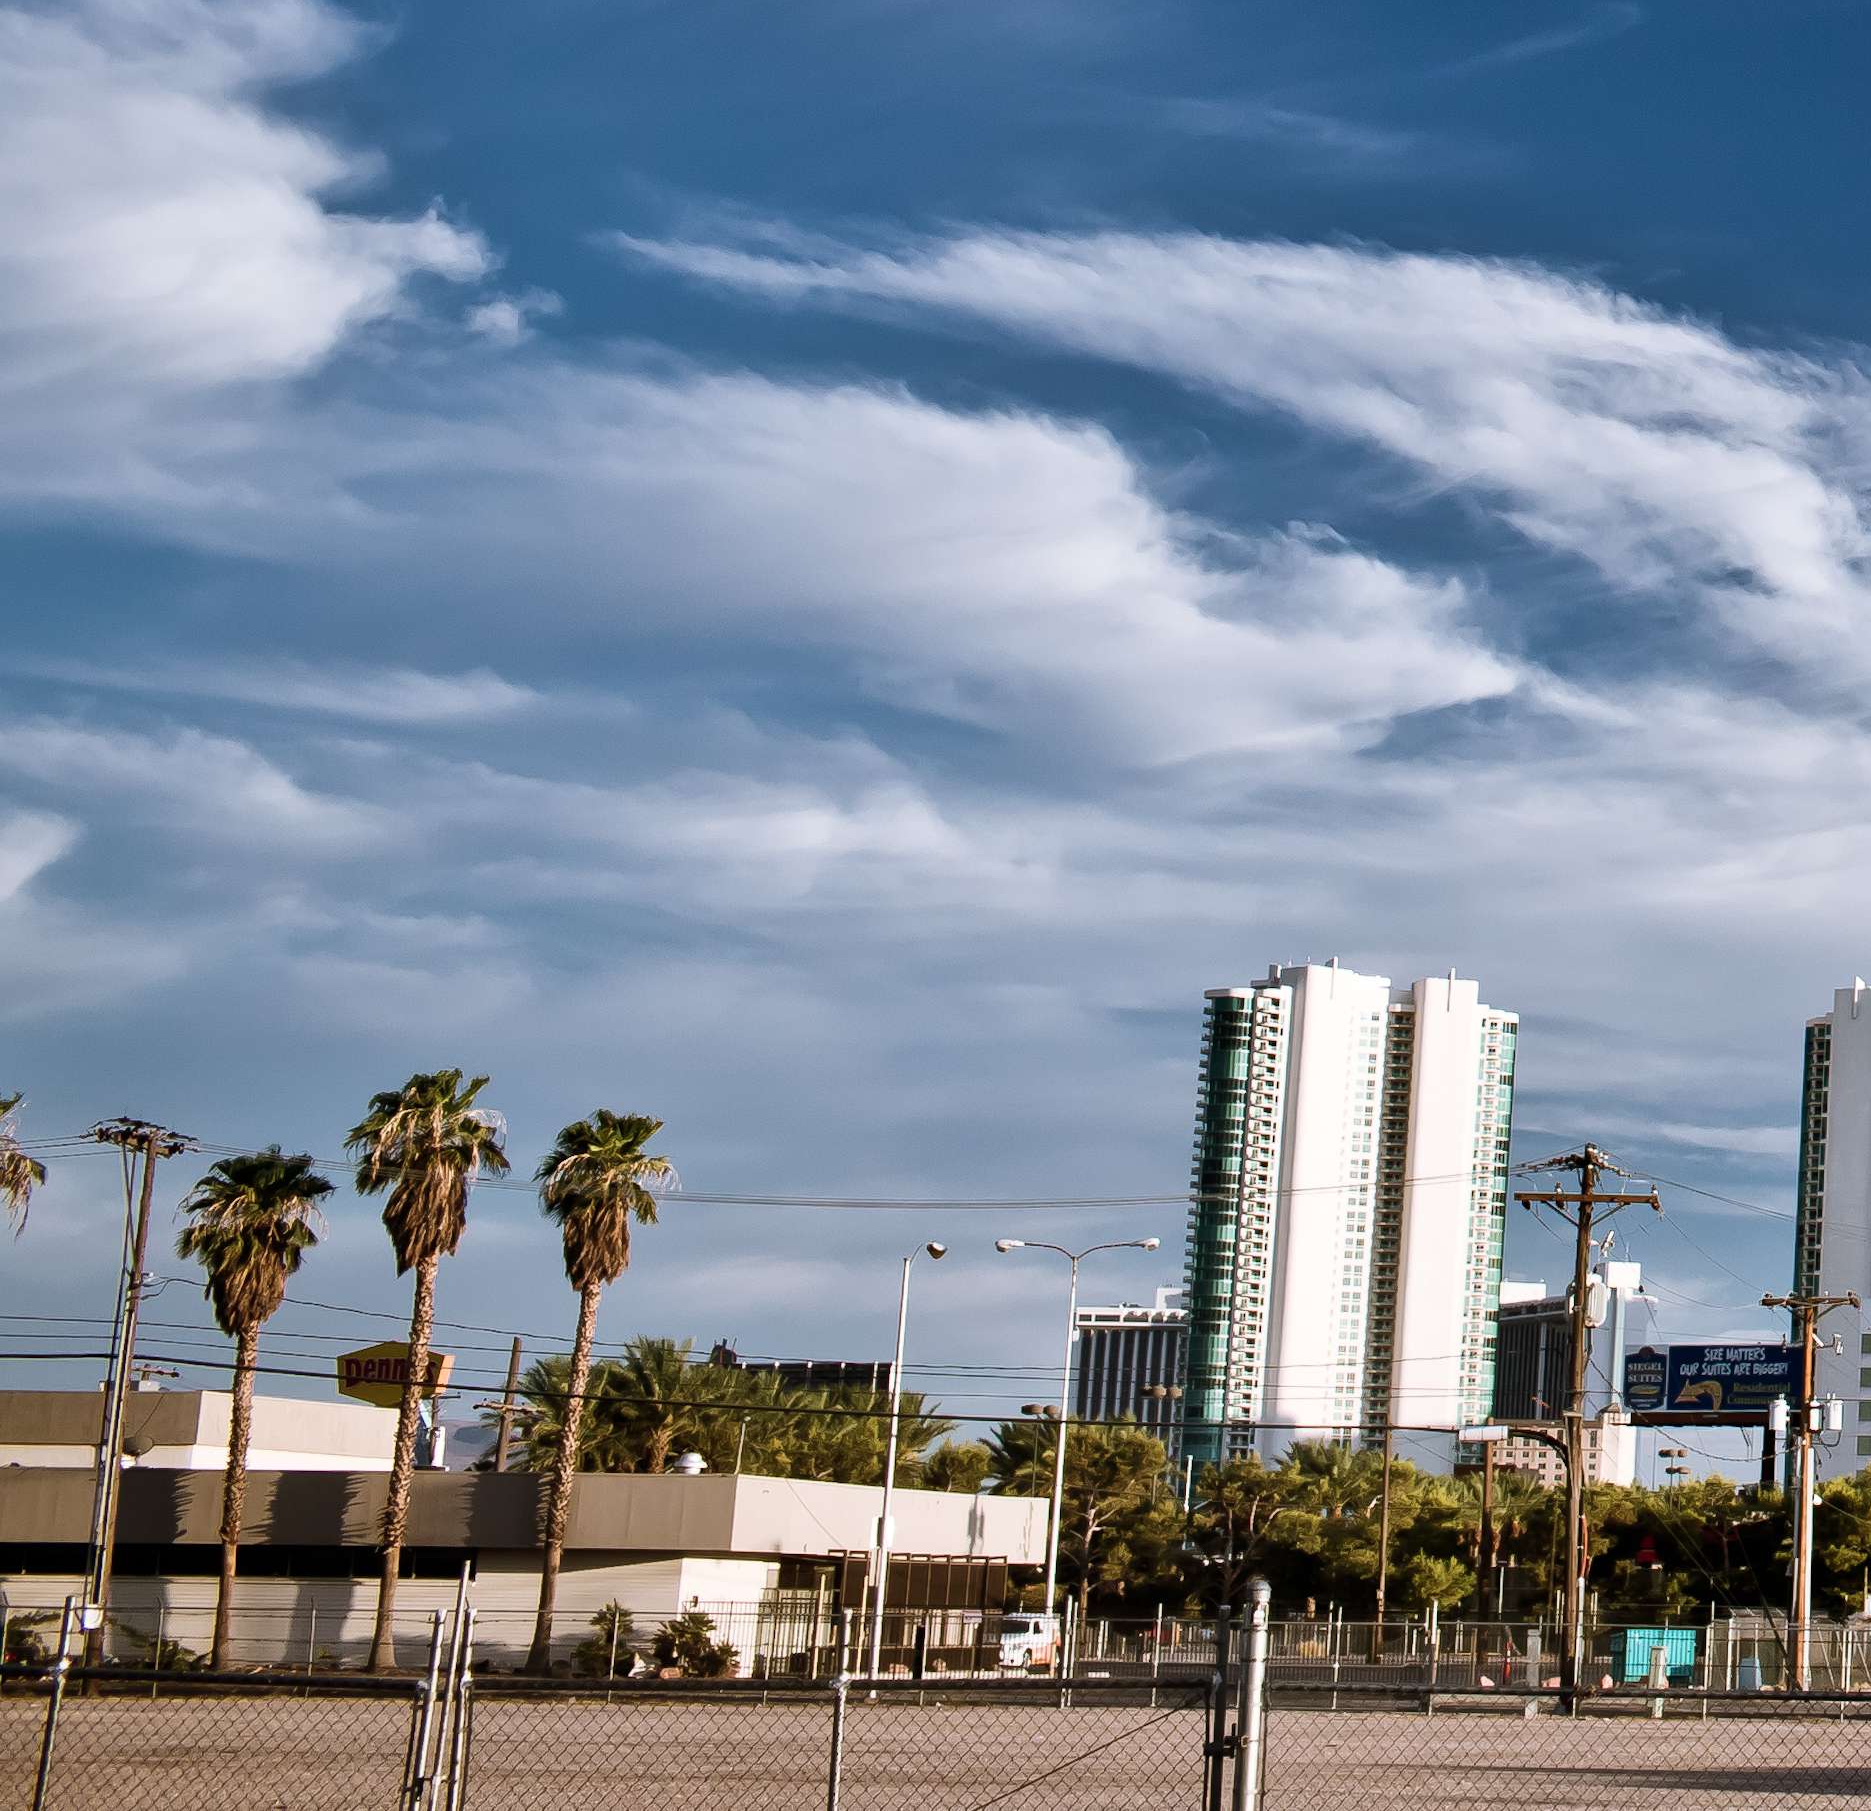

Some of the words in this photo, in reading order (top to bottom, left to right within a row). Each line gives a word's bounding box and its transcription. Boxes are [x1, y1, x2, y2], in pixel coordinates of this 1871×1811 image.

[1703, 1348, 1723, 1361] SIZE
[1726, 1347, 1766, 1361] MATTERS
[343, 1356, 438, 1387] Denns
[1680, 1362, 1699, 1376] OUR
[1702, 1363, 1731, 1376] SUITES
[1734, 1363, 1750, 1375] ARE
